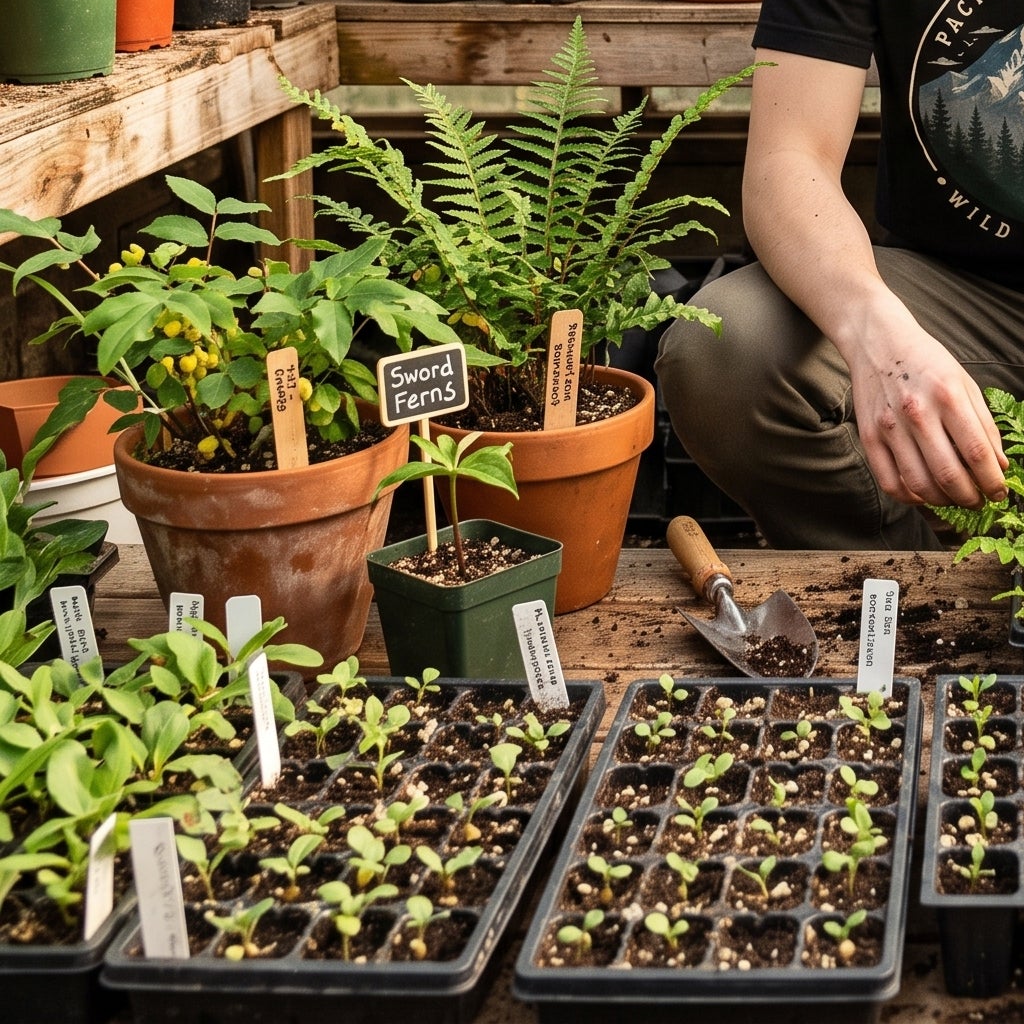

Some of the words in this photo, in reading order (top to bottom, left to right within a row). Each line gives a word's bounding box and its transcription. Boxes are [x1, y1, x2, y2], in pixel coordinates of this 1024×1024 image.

[948, 189, 1011, 239] WILD
[390, 354, 454, 388] Sword
[394, 381, 457, 414] Ferns
